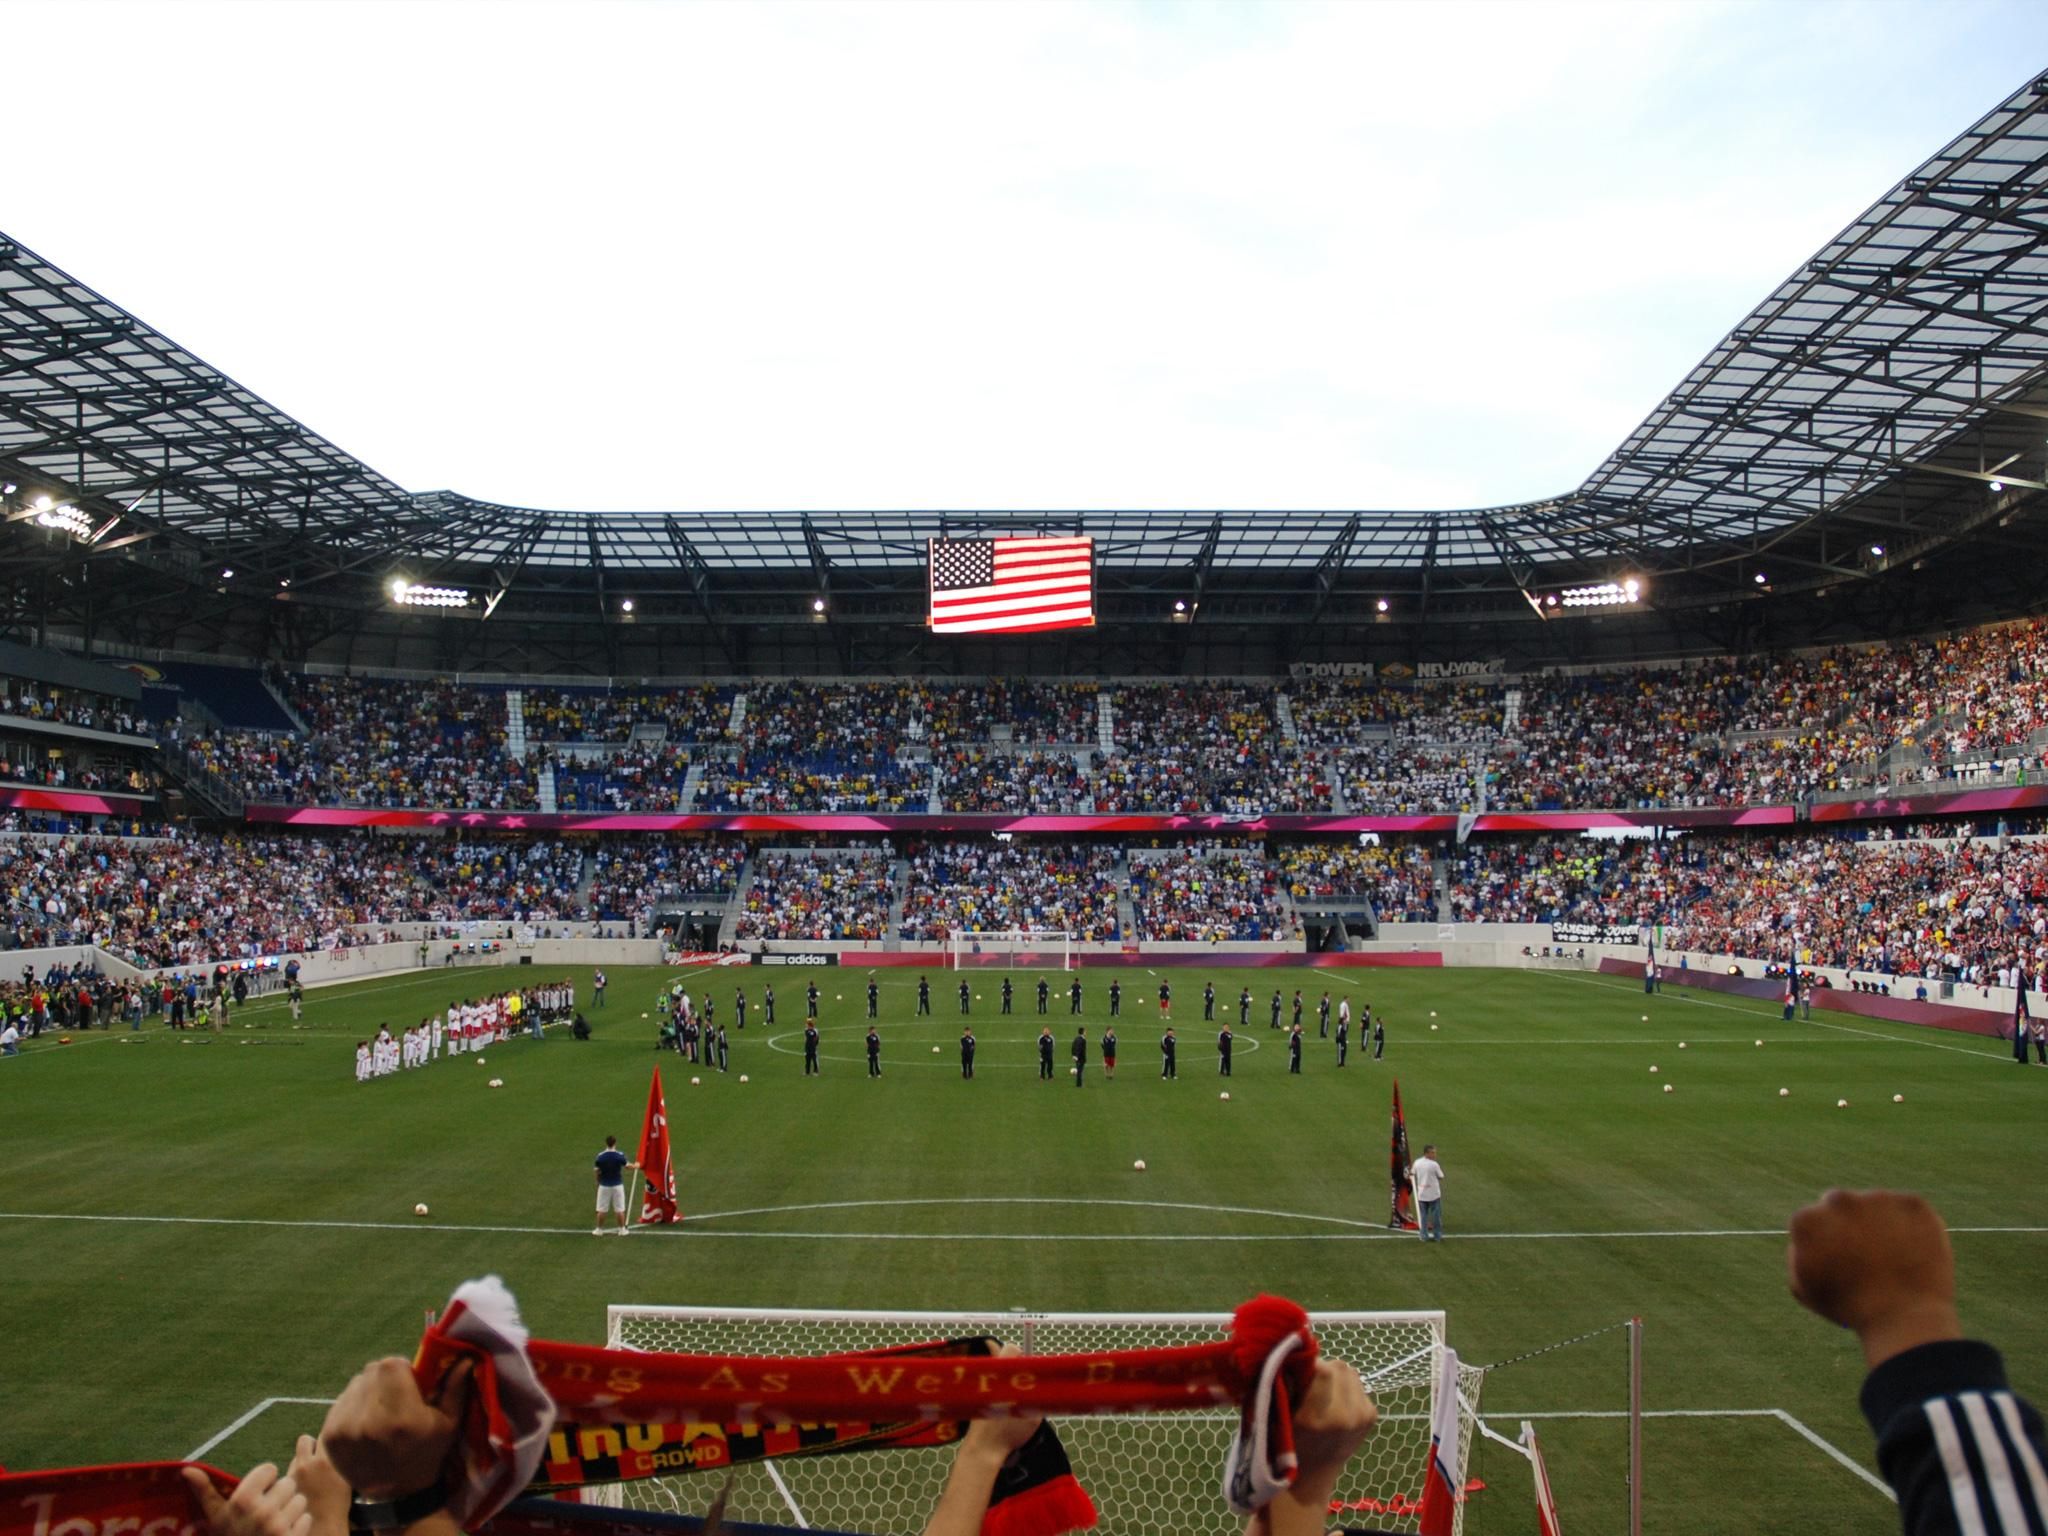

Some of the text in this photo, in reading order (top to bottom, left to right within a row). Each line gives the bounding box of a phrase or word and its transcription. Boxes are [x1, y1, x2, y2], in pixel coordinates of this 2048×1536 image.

[1305, 662, 1374, 678] JOVEM
[787, 954, 827, 965] adidas
[699, 1365, 790, 1393] As
[845, 1365, 1038, 1395] We're
[635, 1445, 722, 1471] CROWD
